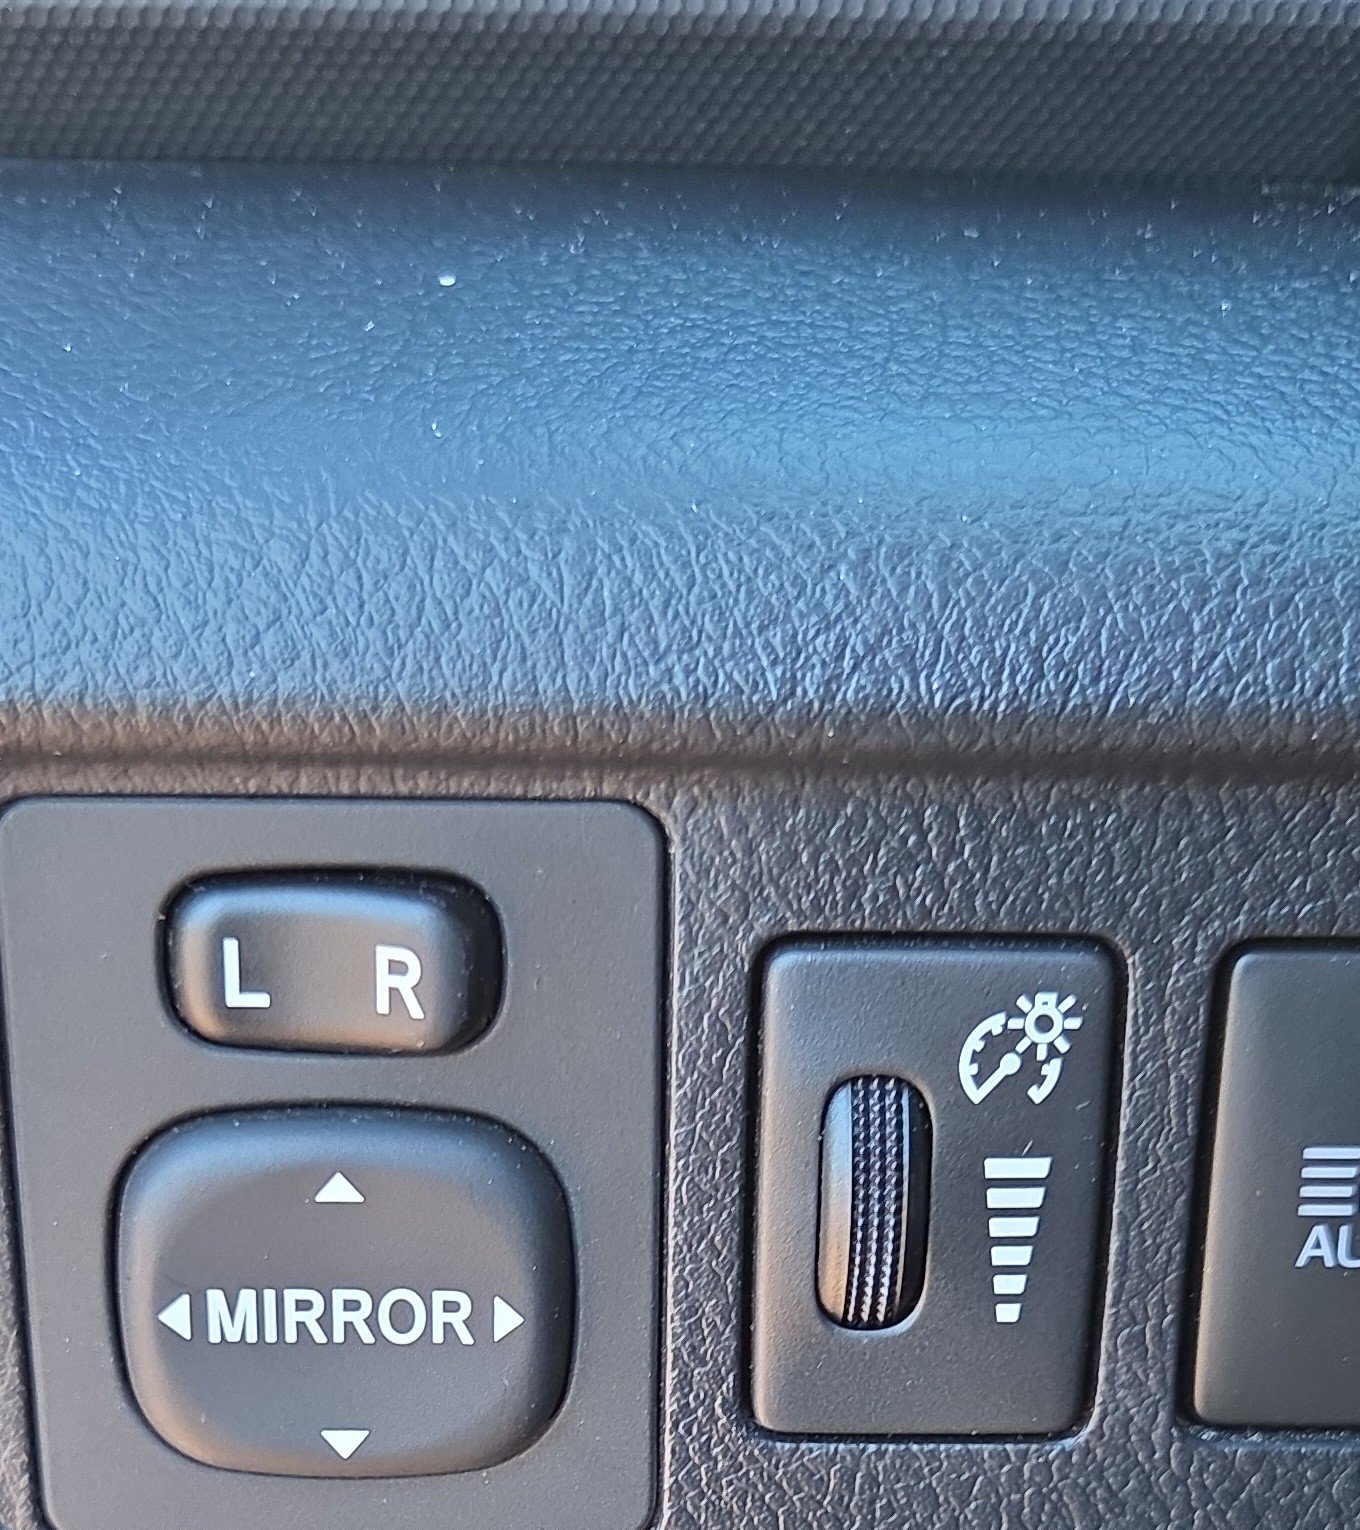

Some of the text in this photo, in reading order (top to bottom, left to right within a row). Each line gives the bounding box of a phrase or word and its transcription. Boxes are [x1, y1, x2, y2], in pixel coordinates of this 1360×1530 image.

[223, 936, 425, 1020] L R
[205, 1288, 476, 1345] MIRROR
